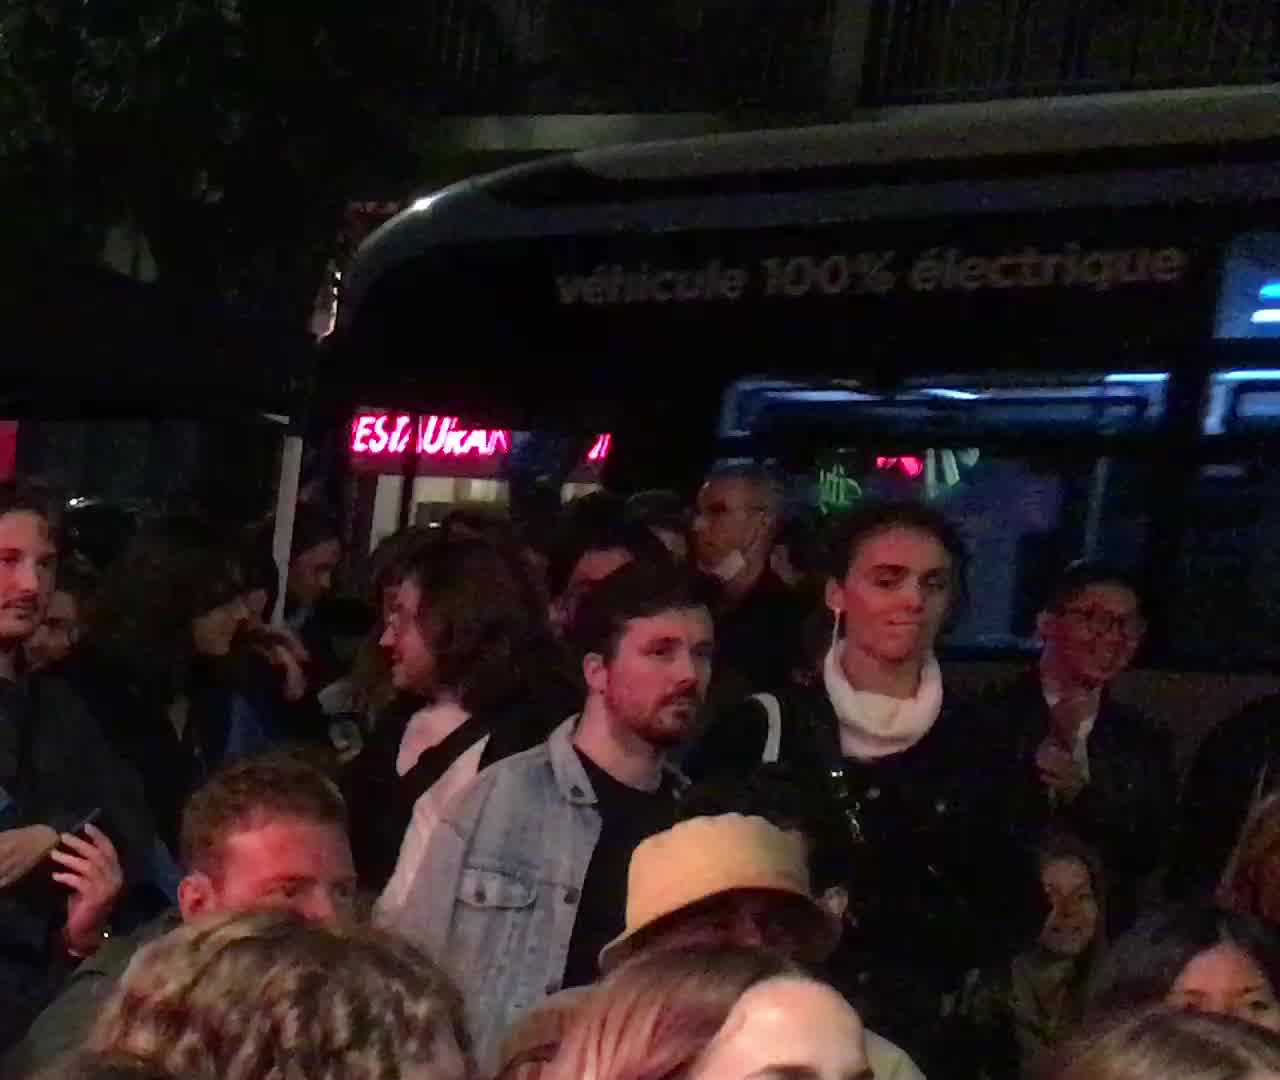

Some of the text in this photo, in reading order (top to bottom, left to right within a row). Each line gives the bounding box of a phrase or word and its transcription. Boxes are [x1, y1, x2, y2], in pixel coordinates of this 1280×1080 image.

[554, 241, 1184, 306] véhicule 100% électrique
